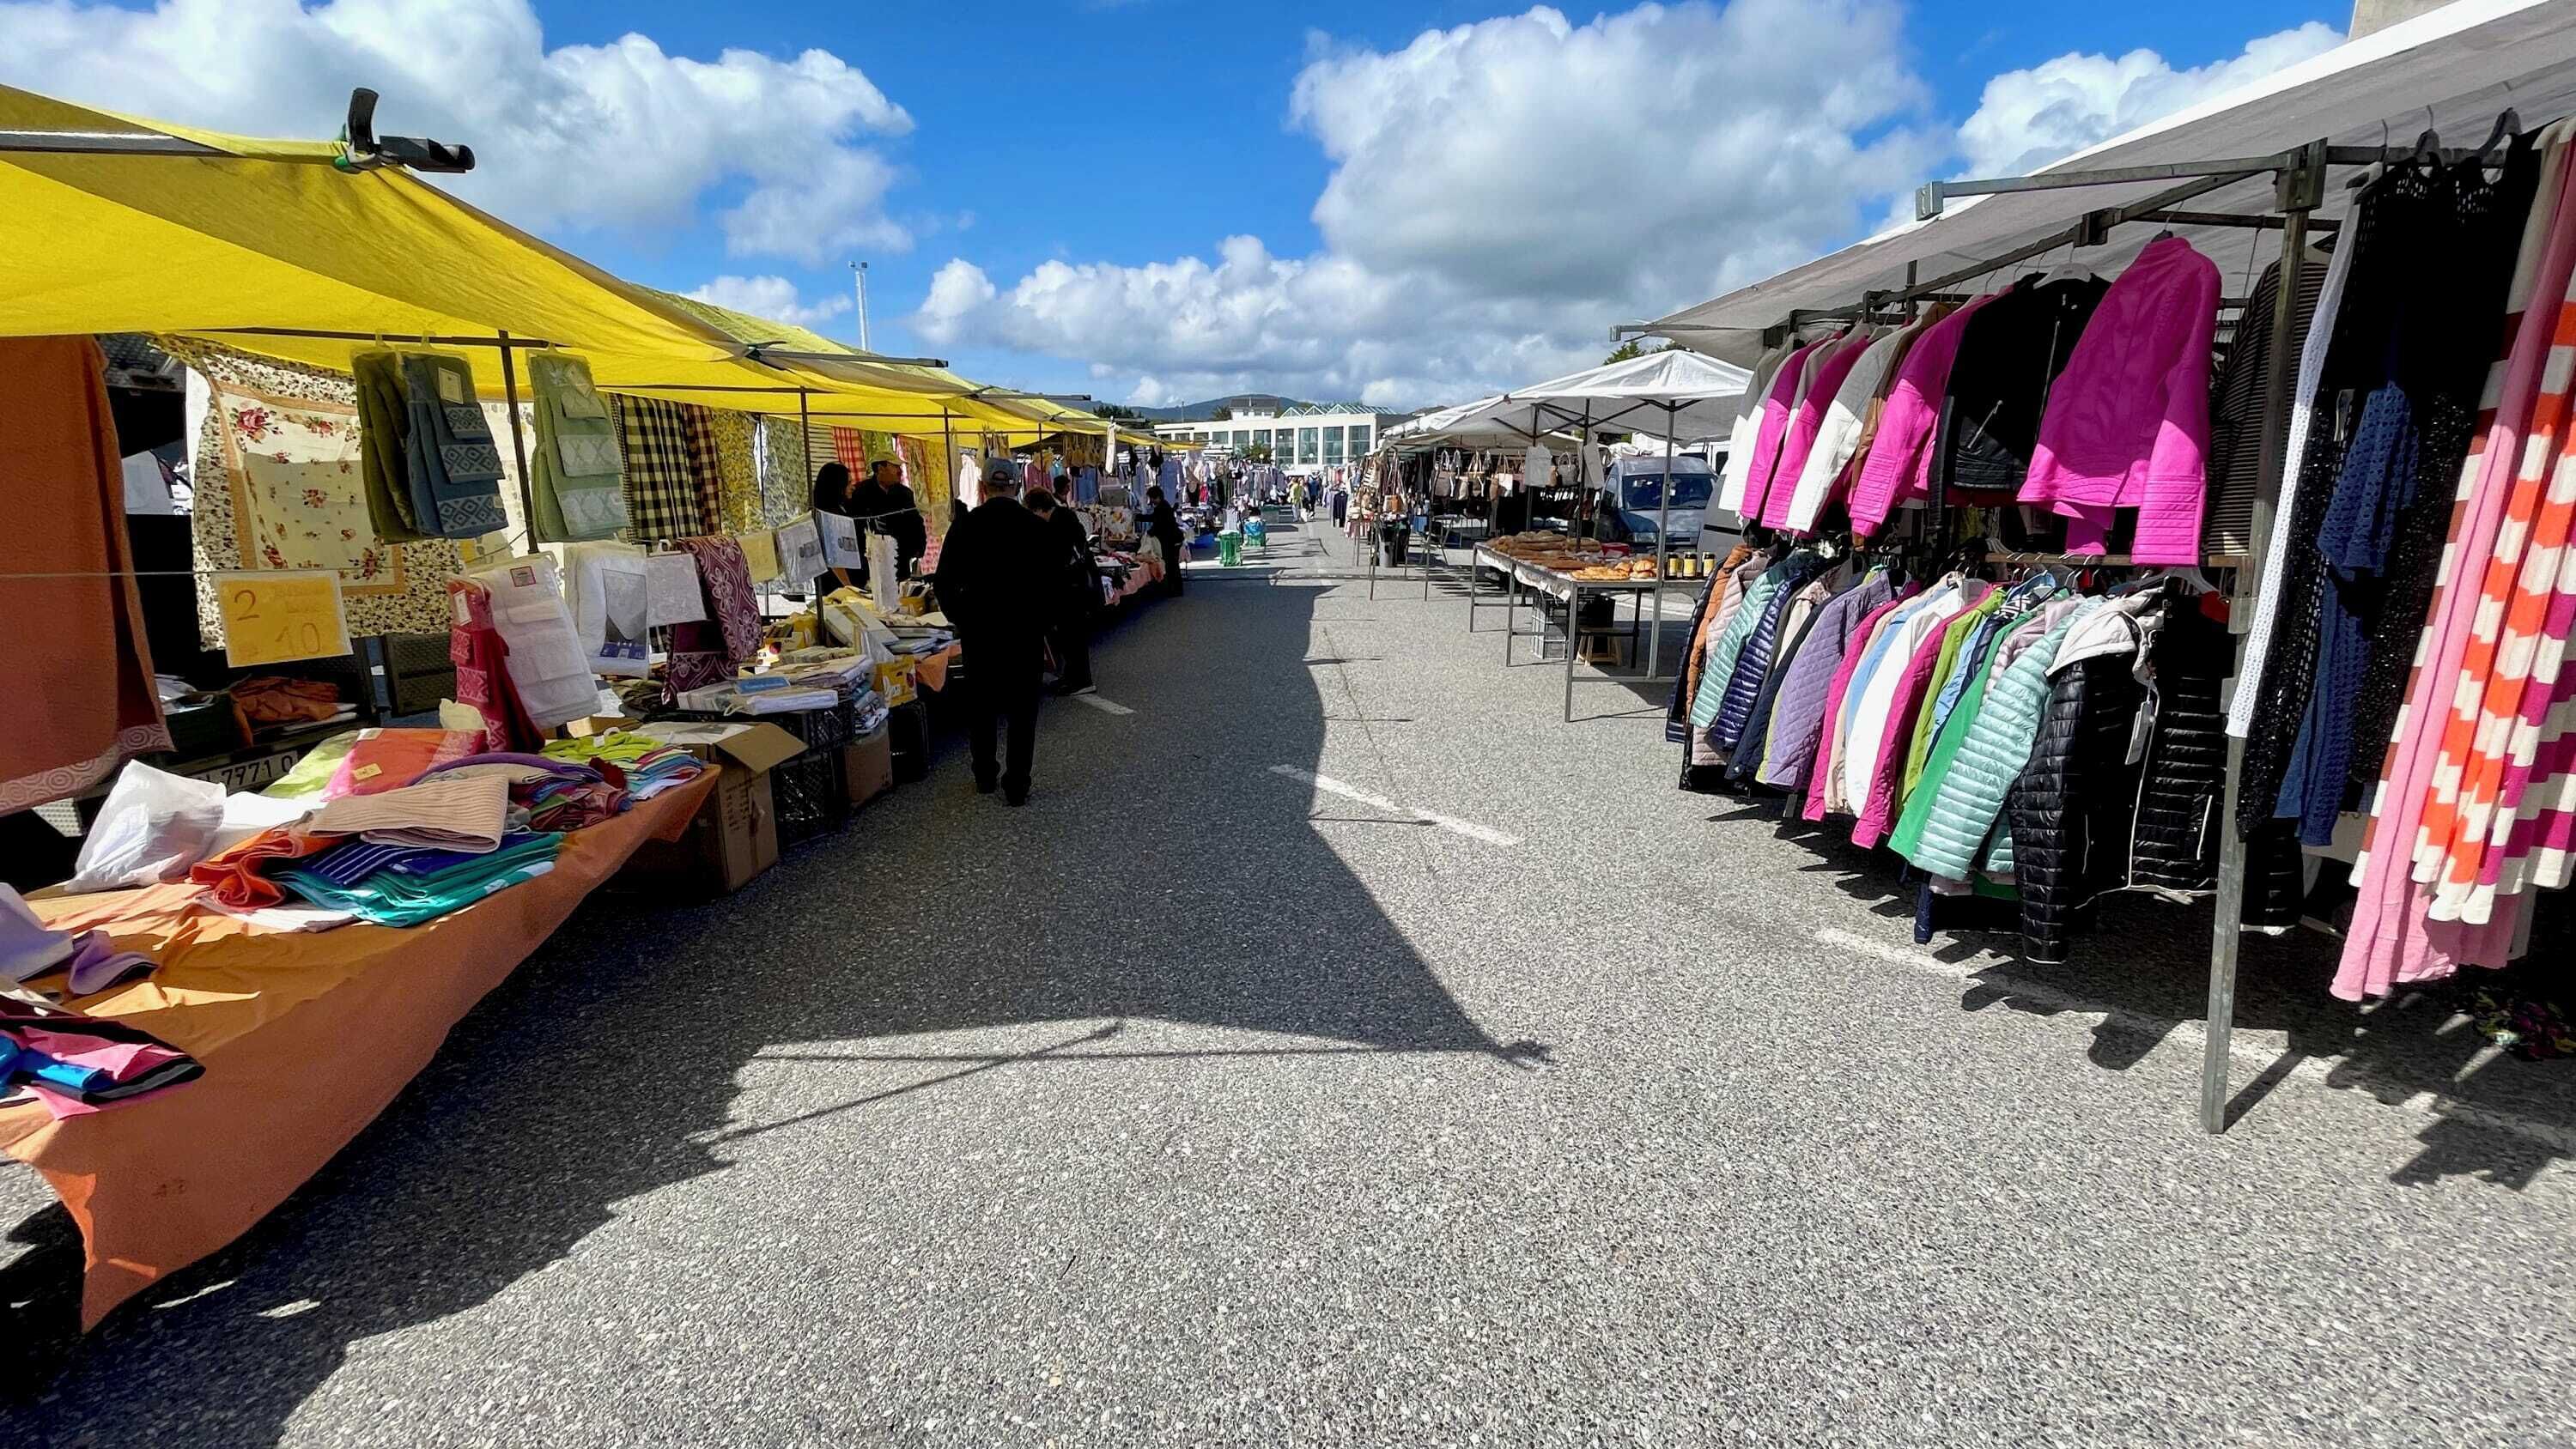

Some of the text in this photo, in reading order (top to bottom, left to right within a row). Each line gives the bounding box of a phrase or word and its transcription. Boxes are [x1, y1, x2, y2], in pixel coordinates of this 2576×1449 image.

[234, 589, 260, 621] 2
[274, 621, 321, 658] 10
[221, 760, 272, 786] 7771
